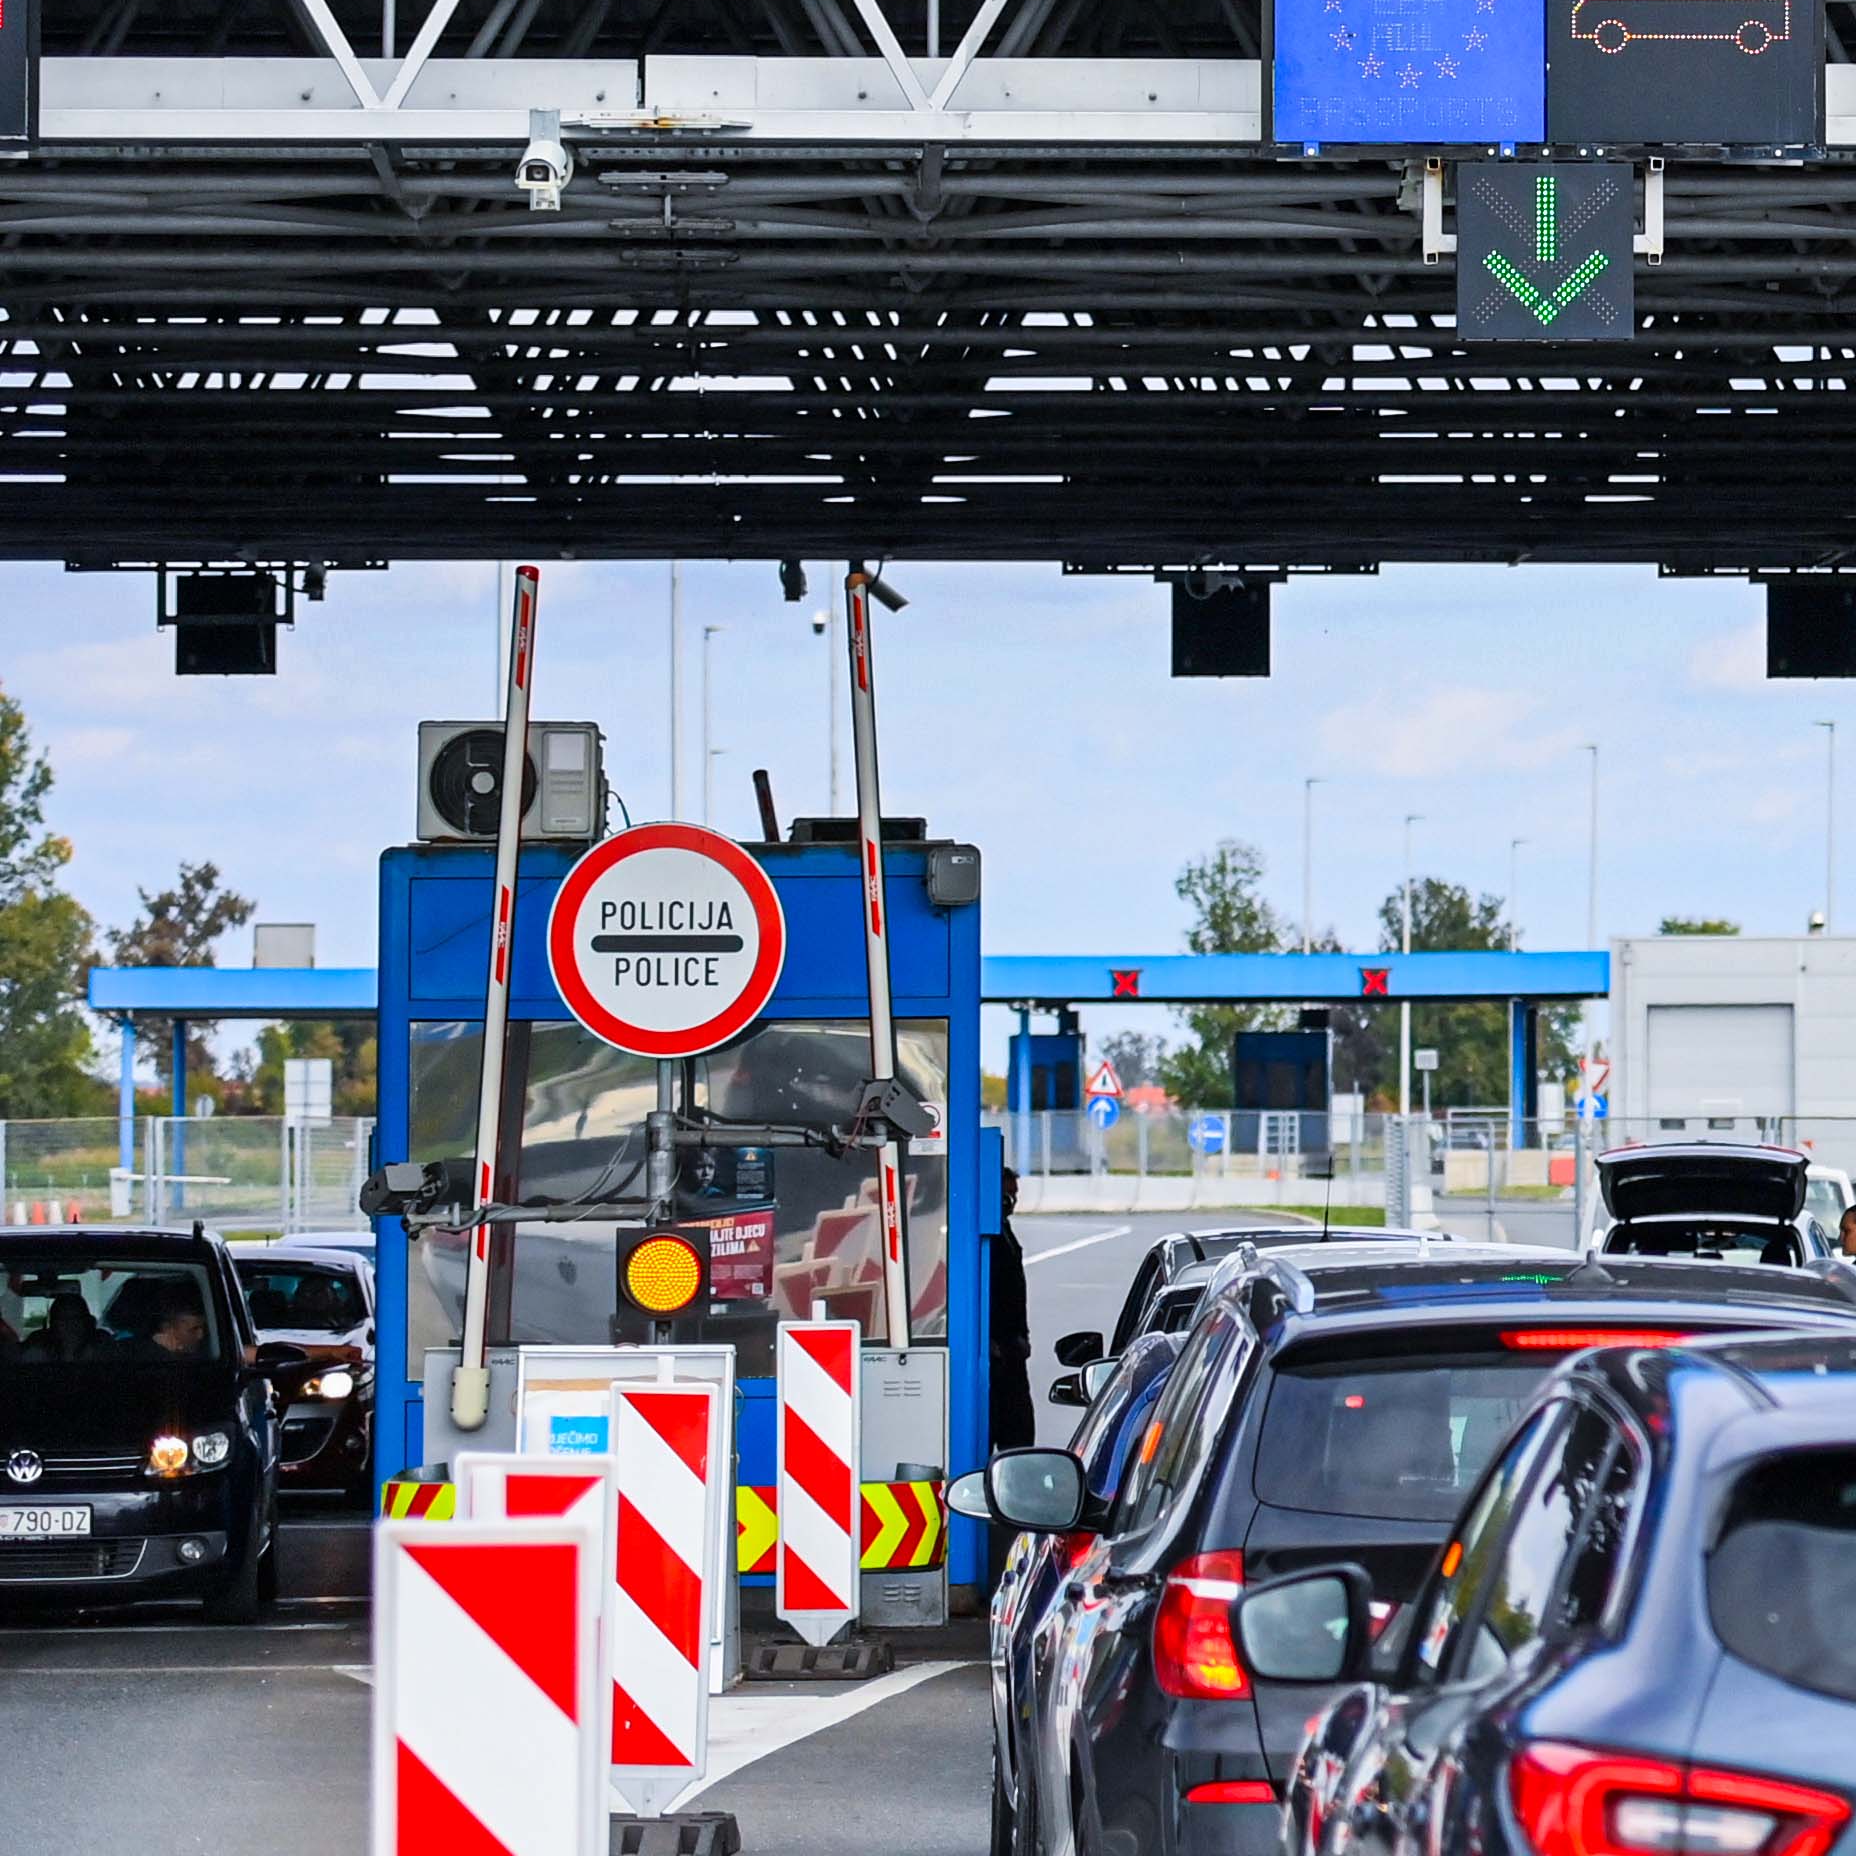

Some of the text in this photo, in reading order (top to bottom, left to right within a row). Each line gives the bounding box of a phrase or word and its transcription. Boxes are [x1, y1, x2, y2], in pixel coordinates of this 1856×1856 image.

[601, 901, 733, 930] POLICIJA
[615, 957, 719, 986] POLICE
[736, 1224, 766, 1240] DJECU
[13, 1511, 88, 1532] 790-DZ
